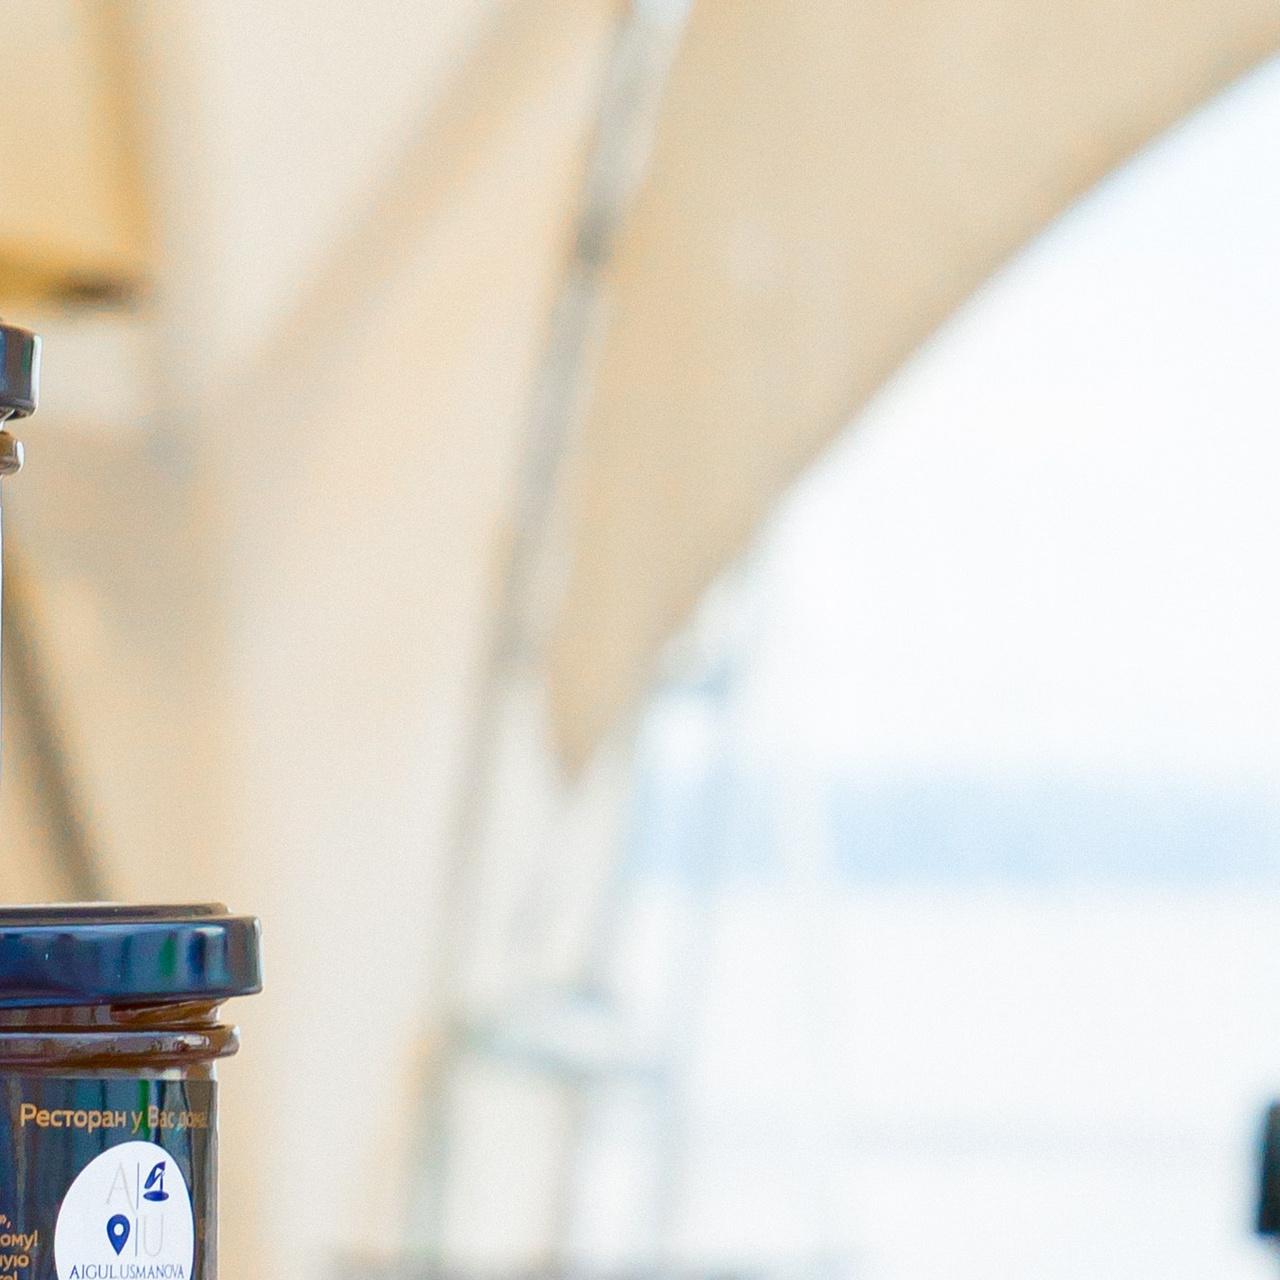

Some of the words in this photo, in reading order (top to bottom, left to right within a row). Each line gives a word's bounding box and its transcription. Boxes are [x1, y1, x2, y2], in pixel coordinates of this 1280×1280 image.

[20, 1104, 127, 1133] Ресторан
[131, 1110, 143, 1134] у
[148, 1104, 175, 1128] Вас
